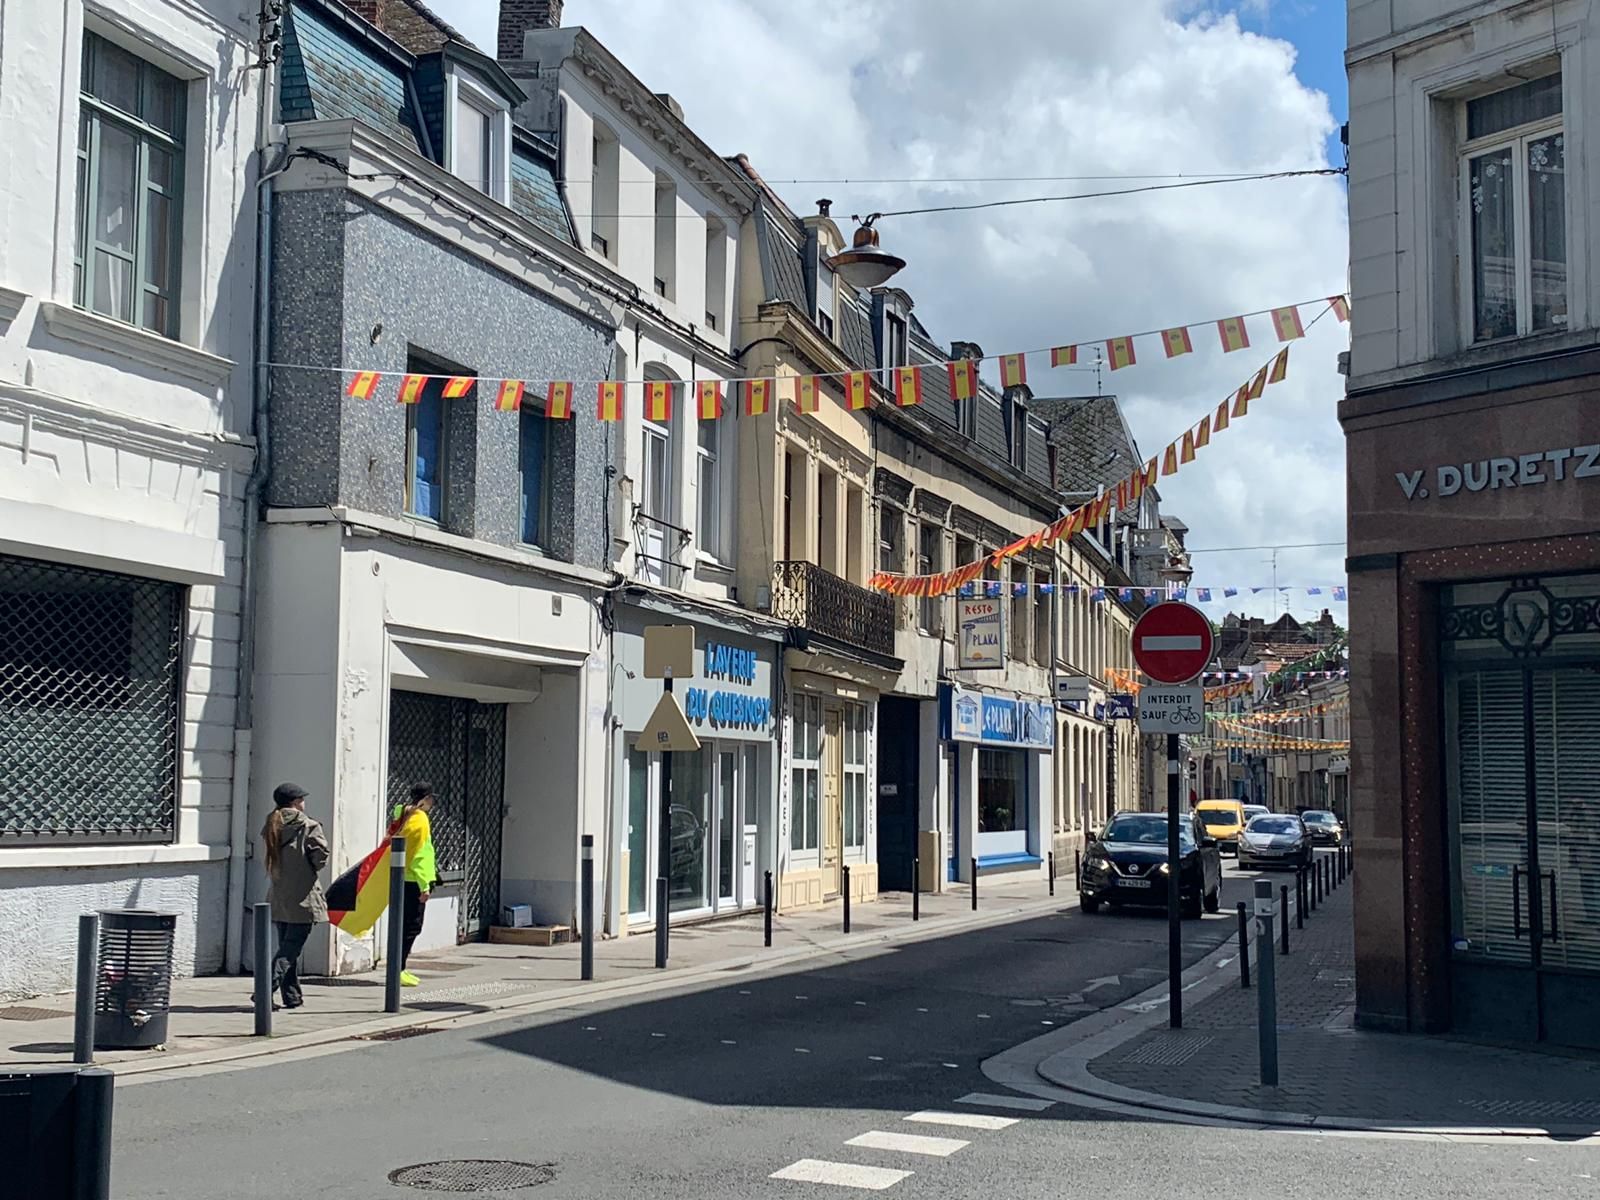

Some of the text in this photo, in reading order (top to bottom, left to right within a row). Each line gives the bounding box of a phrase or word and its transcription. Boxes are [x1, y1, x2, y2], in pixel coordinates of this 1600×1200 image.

[1395, 444, 1600, 499] V. DURETZ
[965, 604, 993, 615] RESTO
[973, 634, 998, 646] PLAKA
[706, 642, 757, 679] LAVERIE
[1147, 695, 1192, 704] INTERDIT
[687, 687, 771, 725] DU QUESNOY
[1110, 706, 1130, 717] AXA
[1141, 710, 1168, 720] SAUF
